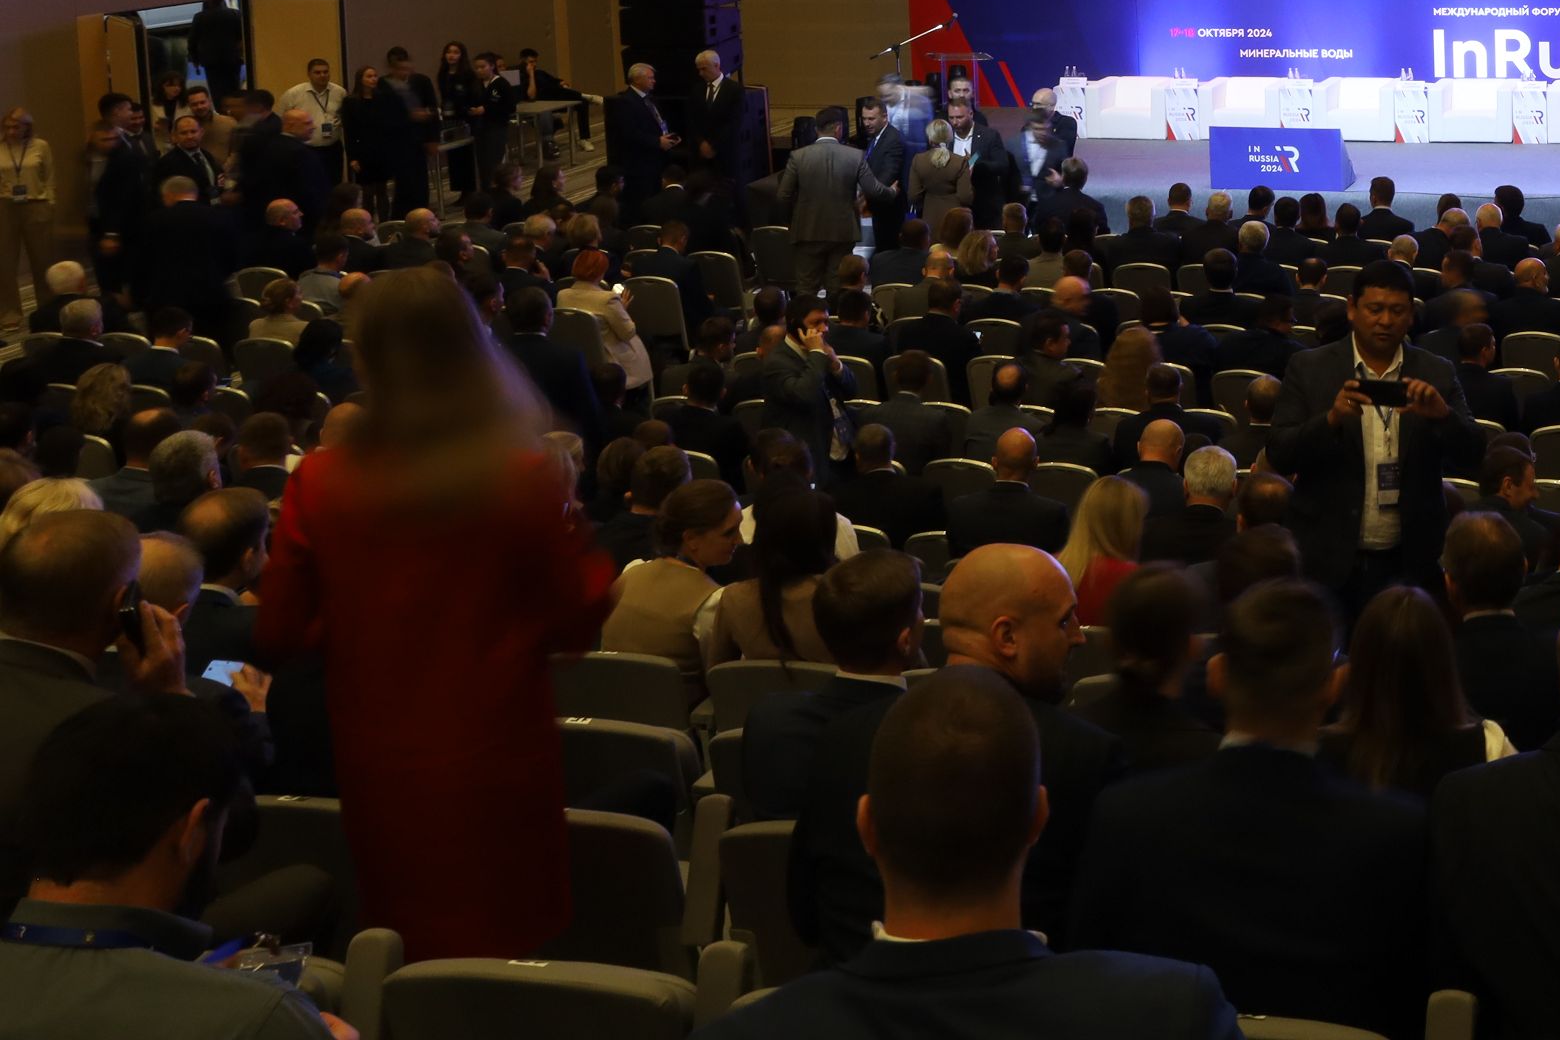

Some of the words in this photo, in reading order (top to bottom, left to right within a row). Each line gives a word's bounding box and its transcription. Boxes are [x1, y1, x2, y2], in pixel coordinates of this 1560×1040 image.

[1433, 5, 1530, 18] МЕЖДУНАРОДНЫЙ
[1197, 28, 1244, 38] ОКТЯБРЯ
[1247, 28, 1272, 38] 2024
[1240, 49, 1319, 58] МИНЕРАЛЬНЫЕ
[1321, 49, 1353, 59] ВОДЫ
[1261, 164, 1283, 172] 2024
